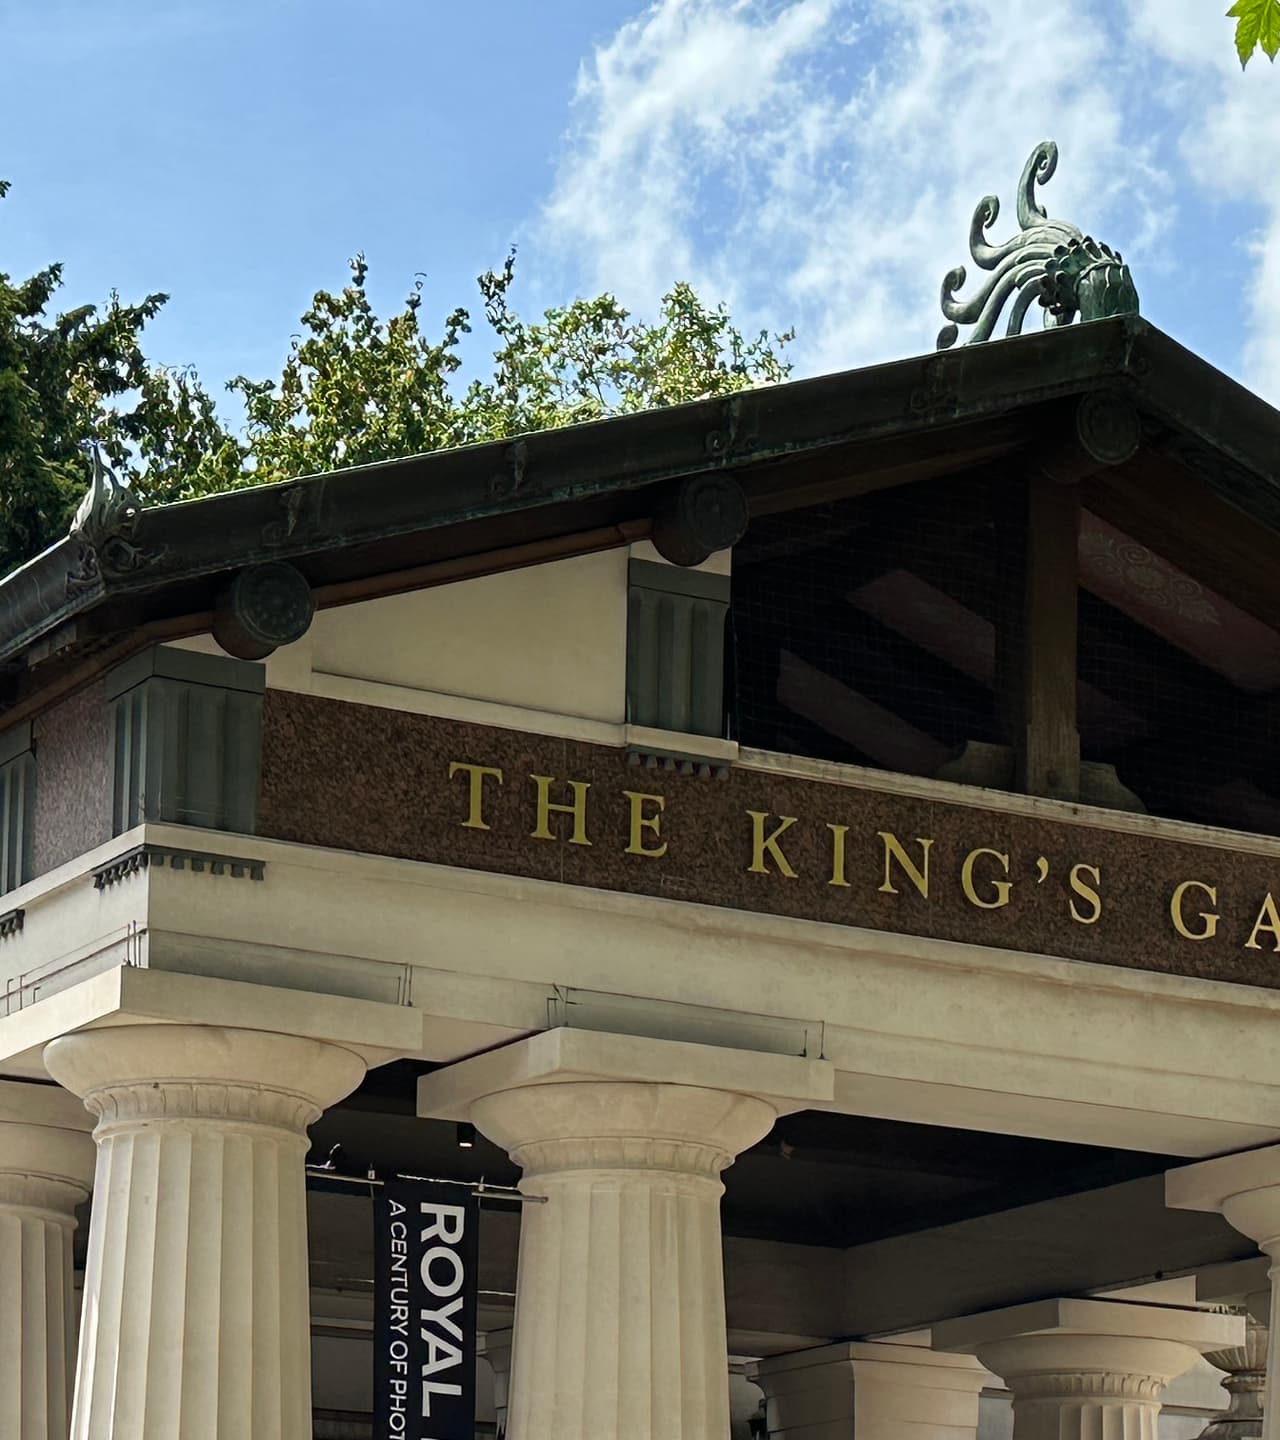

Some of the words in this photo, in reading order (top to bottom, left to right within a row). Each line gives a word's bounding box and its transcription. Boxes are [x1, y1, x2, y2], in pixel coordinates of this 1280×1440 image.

[449, 761, 668, 858] THE
[745, 809, 1103, 925] KING'S
[389, 1199, 407, 1216] A
[389, 1221, 409, 1337] CENTURY
[420, 1201, 466, 1417] ROYAL
[389, 1340, 409, 1376] OF
